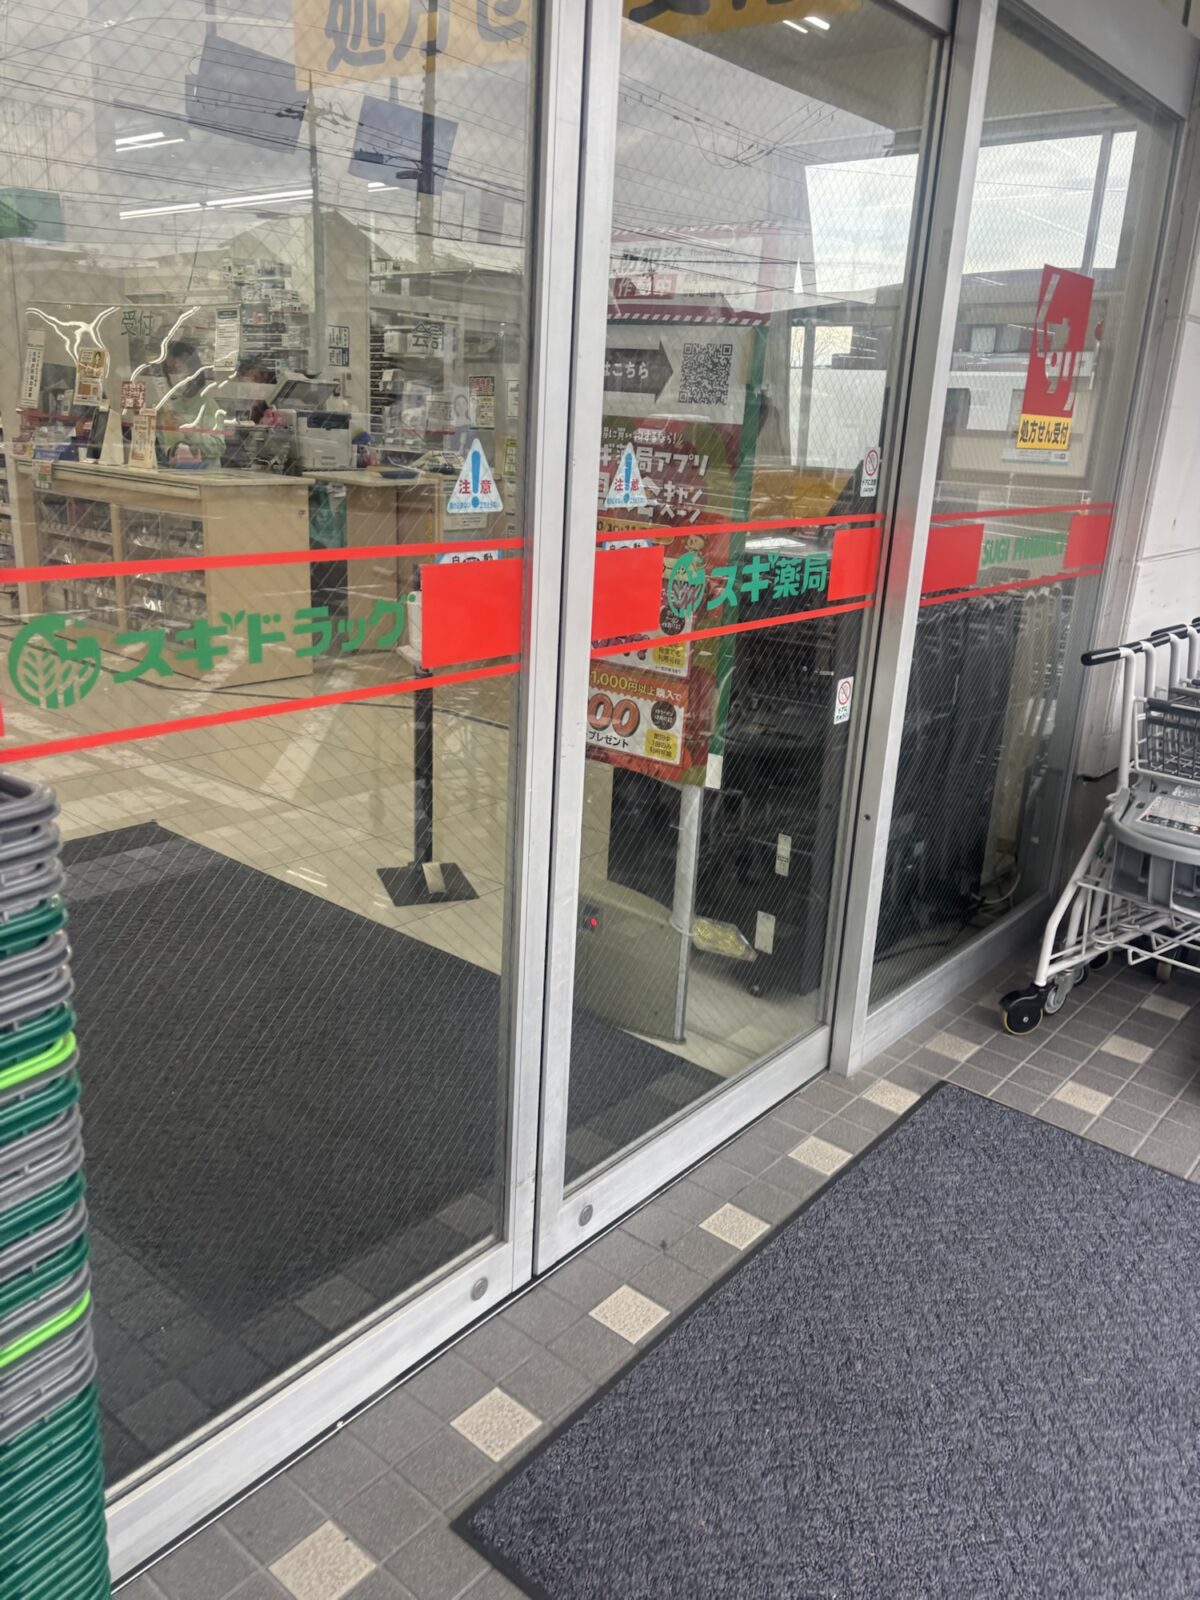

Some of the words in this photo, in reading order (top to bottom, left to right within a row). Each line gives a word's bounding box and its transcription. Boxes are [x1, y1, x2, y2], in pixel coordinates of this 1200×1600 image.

[121, 310, 153, 336] 受付
[1019, 418, 1069, 445] 処方せん受付
[706, 550, 828, 610] スギ薬局
[111, 593, 416, 684] スギドラッグ
[591, 669, 683, 701] 1,000円以上購入で
